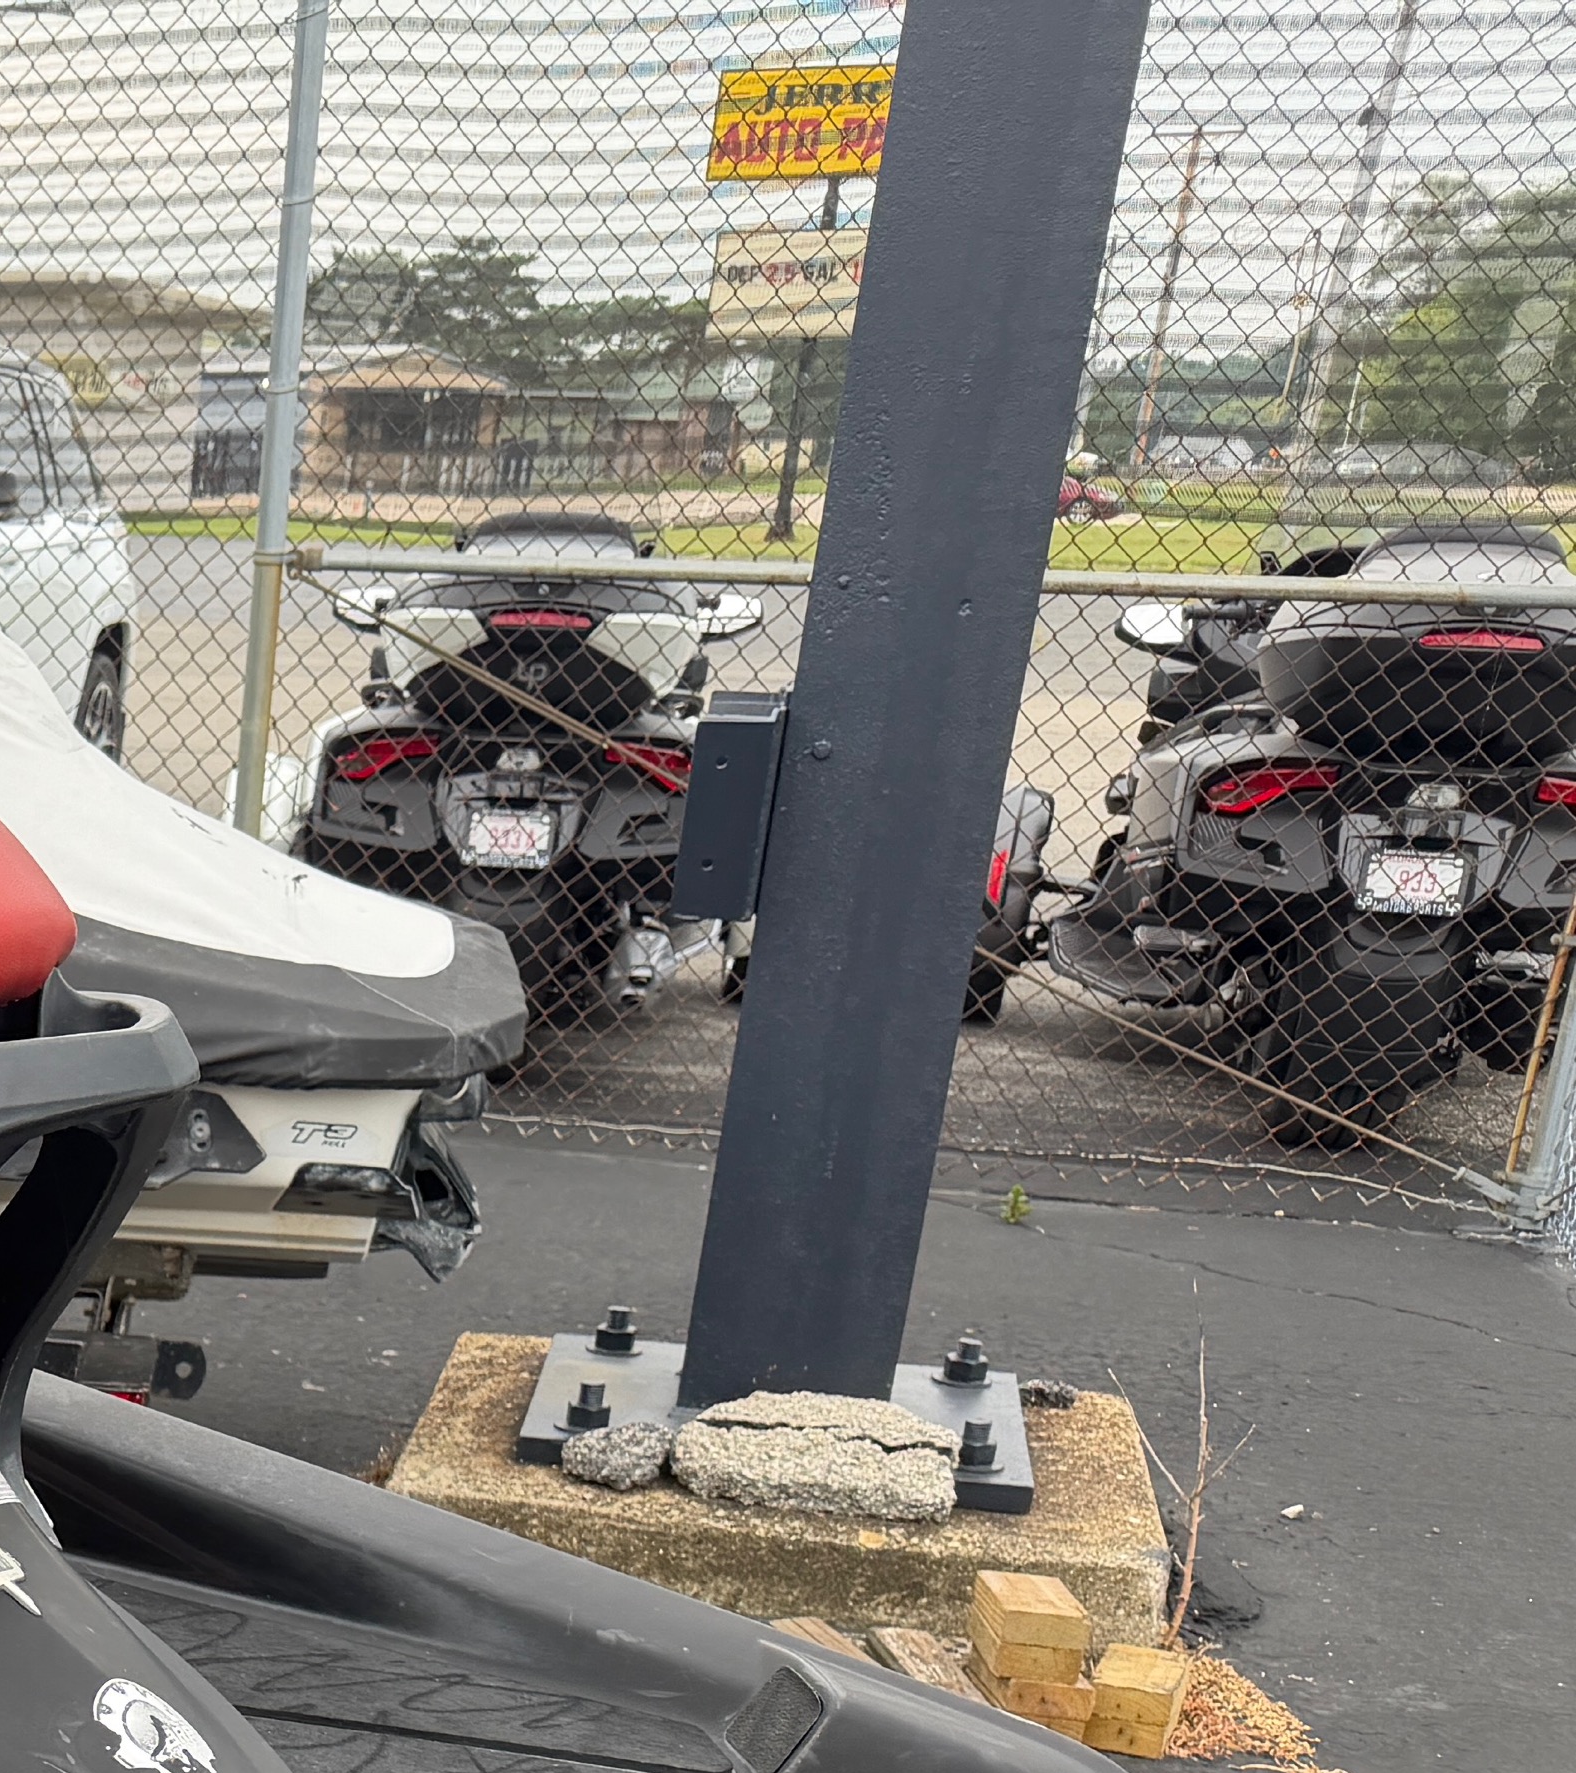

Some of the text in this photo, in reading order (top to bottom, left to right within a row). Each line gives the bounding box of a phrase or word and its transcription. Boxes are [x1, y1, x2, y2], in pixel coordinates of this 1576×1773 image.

[753, 80, 892, 115] JERR
[714, 118, 823, 163] AUTO
[291, 1120, 358, 1144] T3
